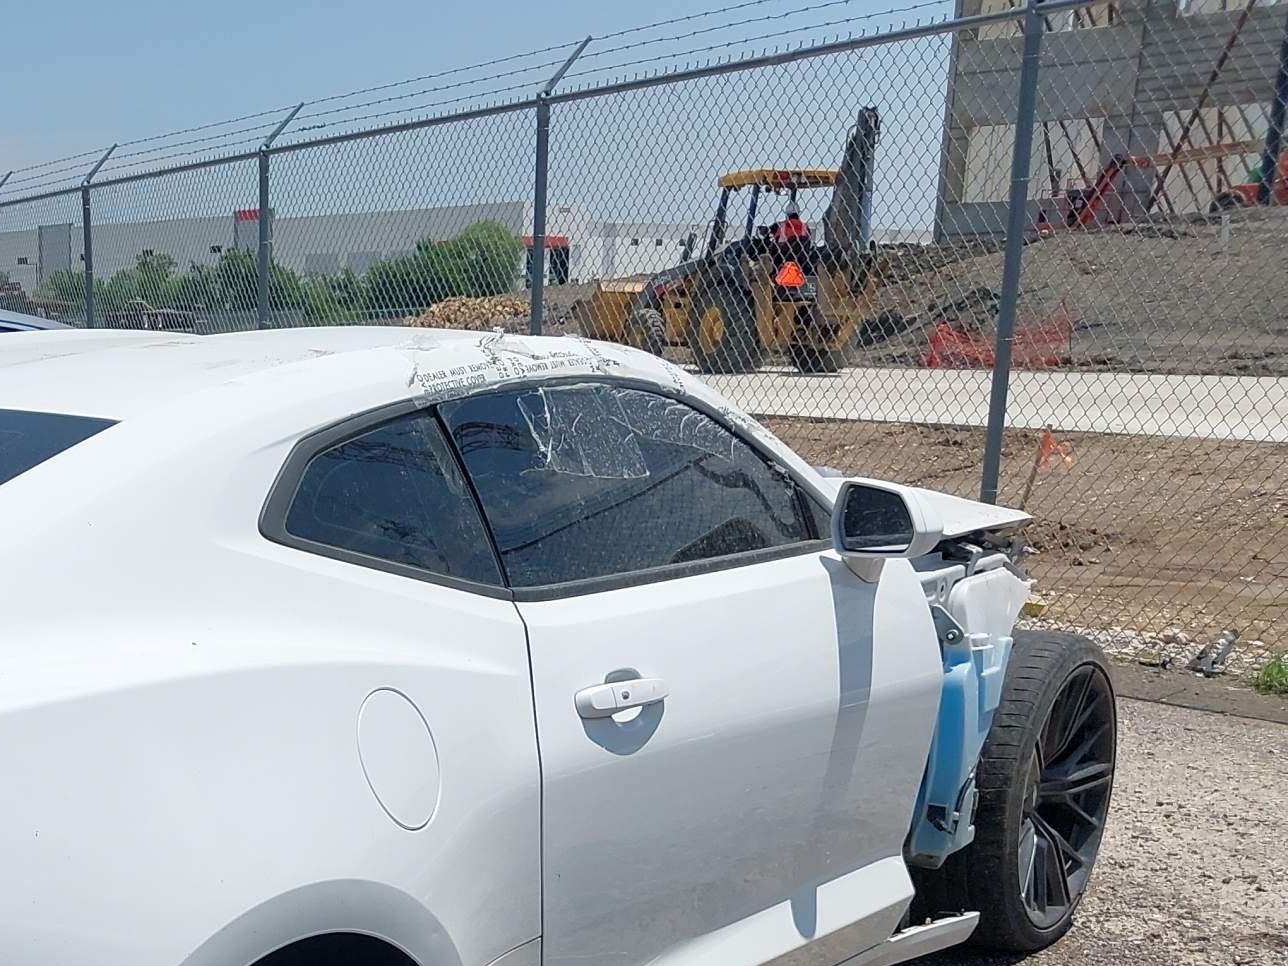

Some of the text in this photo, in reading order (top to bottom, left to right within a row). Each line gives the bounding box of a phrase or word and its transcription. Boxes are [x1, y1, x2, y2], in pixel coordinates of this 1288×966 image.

[422, 369, 447, 383] DEALER
[449, 366, 467, 378] MUST
[466, 373, 487, 386] COVER
